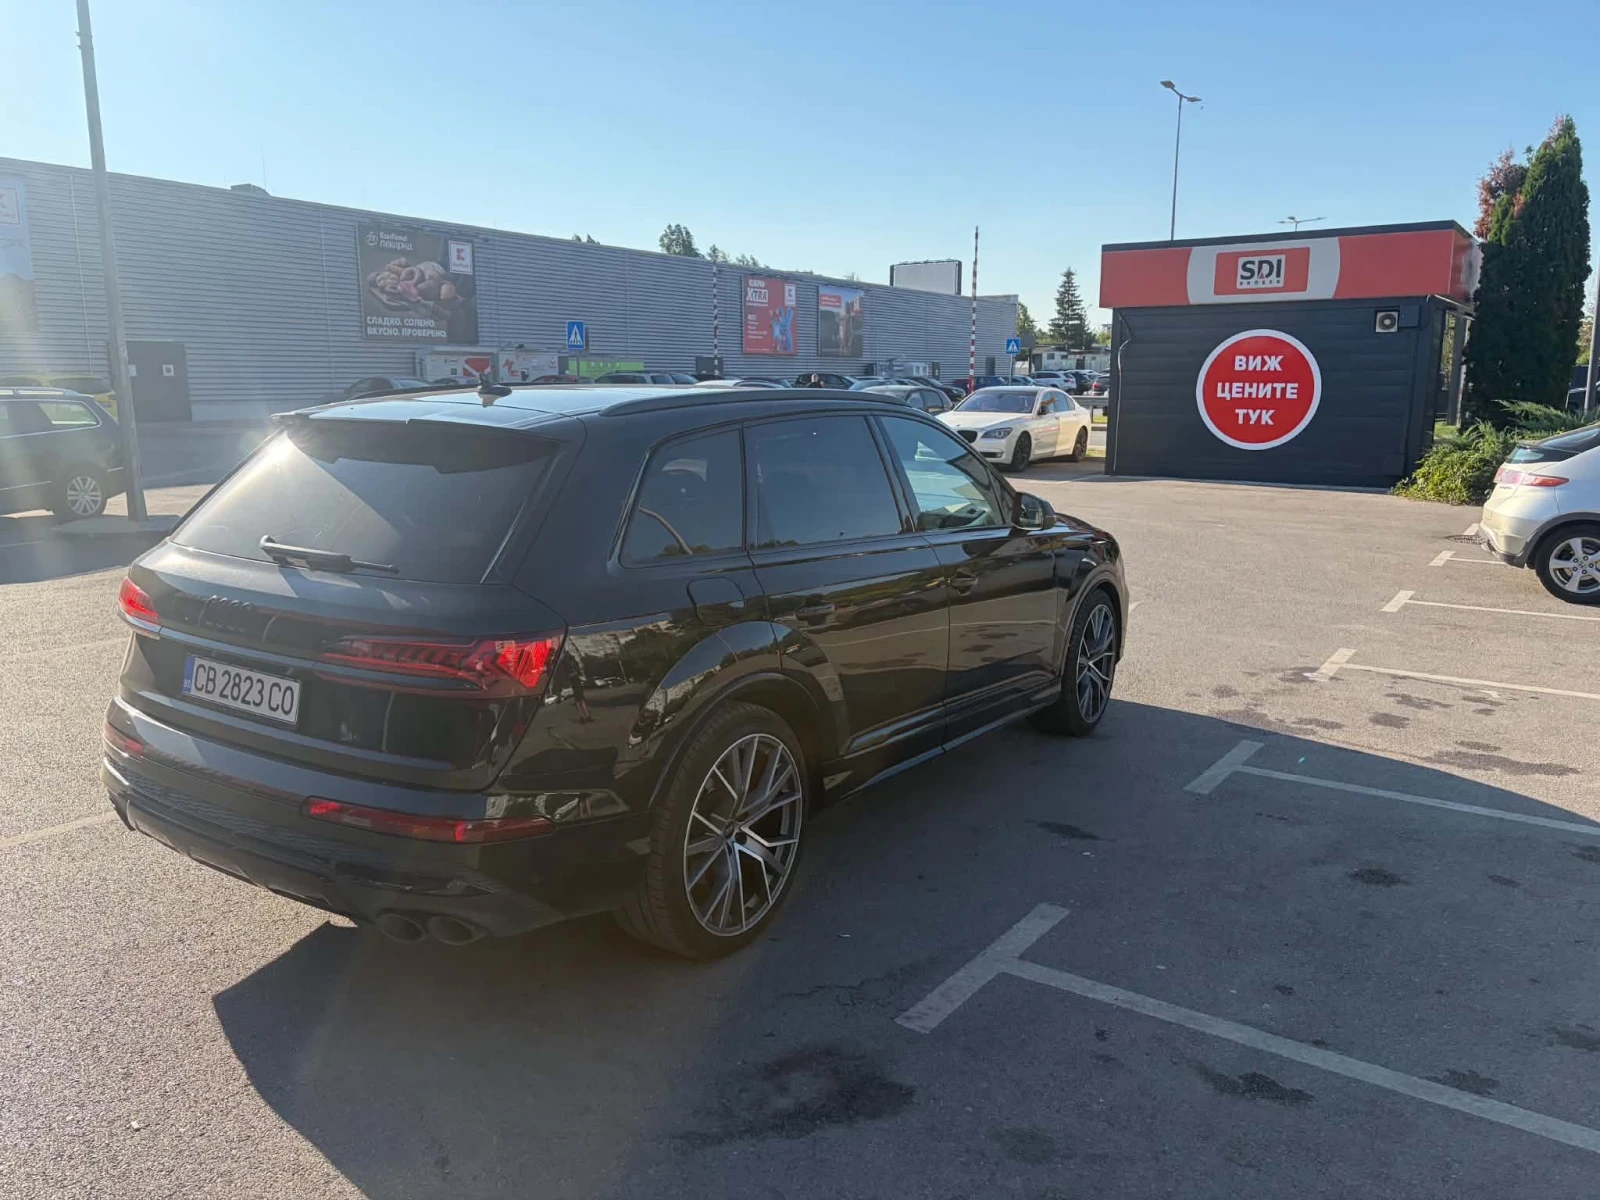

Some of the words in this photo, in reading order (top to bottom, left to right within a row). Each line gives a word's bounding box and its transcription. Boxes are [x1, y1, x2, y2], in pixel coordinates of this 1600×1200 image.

[456, 248, 466, 261] K
[1240, 259, 1282, 280] SDI
[404, 318, 436, 328] СОЛЕНО.
[367, 326, 400, 336] ВКУСНО.
[401, 328, 447, 338] ПРОВЕРЕНО.
[1234, 355, 1284, 371] ВИЖ
[1216, 382, 1299, 400] ЦЕНИТЕ
[1235, 409, 1275, 425] ТУК
